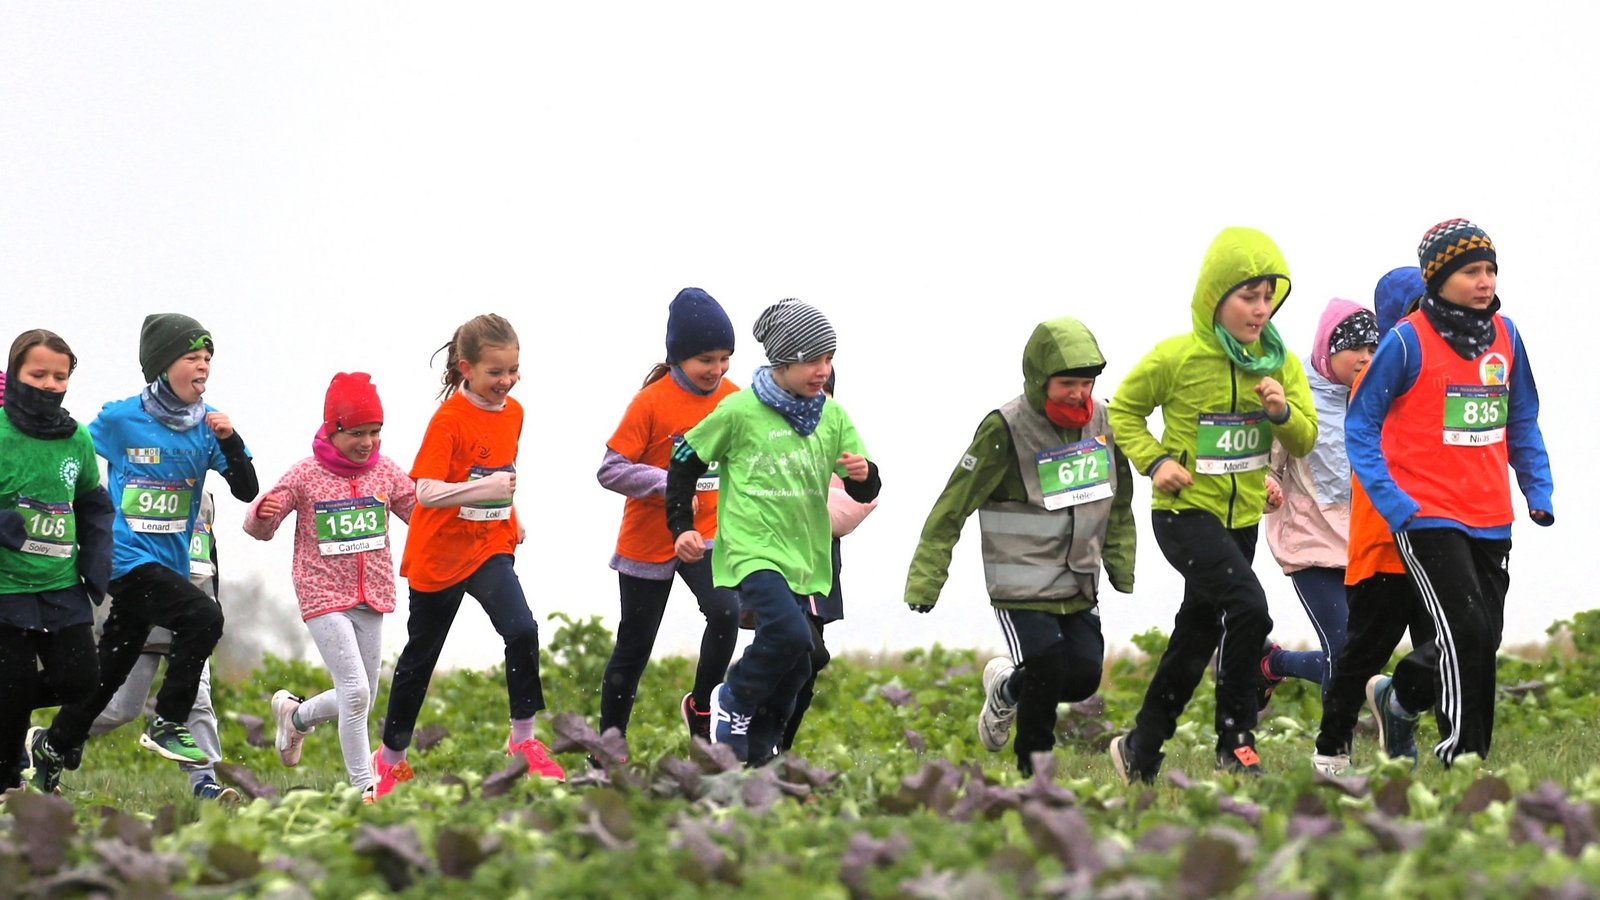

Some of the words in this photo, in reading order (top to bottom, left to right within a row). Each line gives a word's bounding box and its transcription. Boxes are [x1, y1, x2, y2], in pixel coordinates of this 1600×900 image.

[1463, 401, 1500, 424] 835
[768, 429, 792, 441] Meine
[1216, 428, 1259, 452] 400
[1058, 456, 1099, 485] 672
[1224, 462, 1249, 471] Moritz
[138, 492, 179, 513] 940
[485, 511, 500, 519] Loki
[142, 522, 170, 531] Lenard
[326, 511, 378, 536] 1543
[28, 543, 51, 554] Soley
[339, 542, 370, 552] Carlotta
